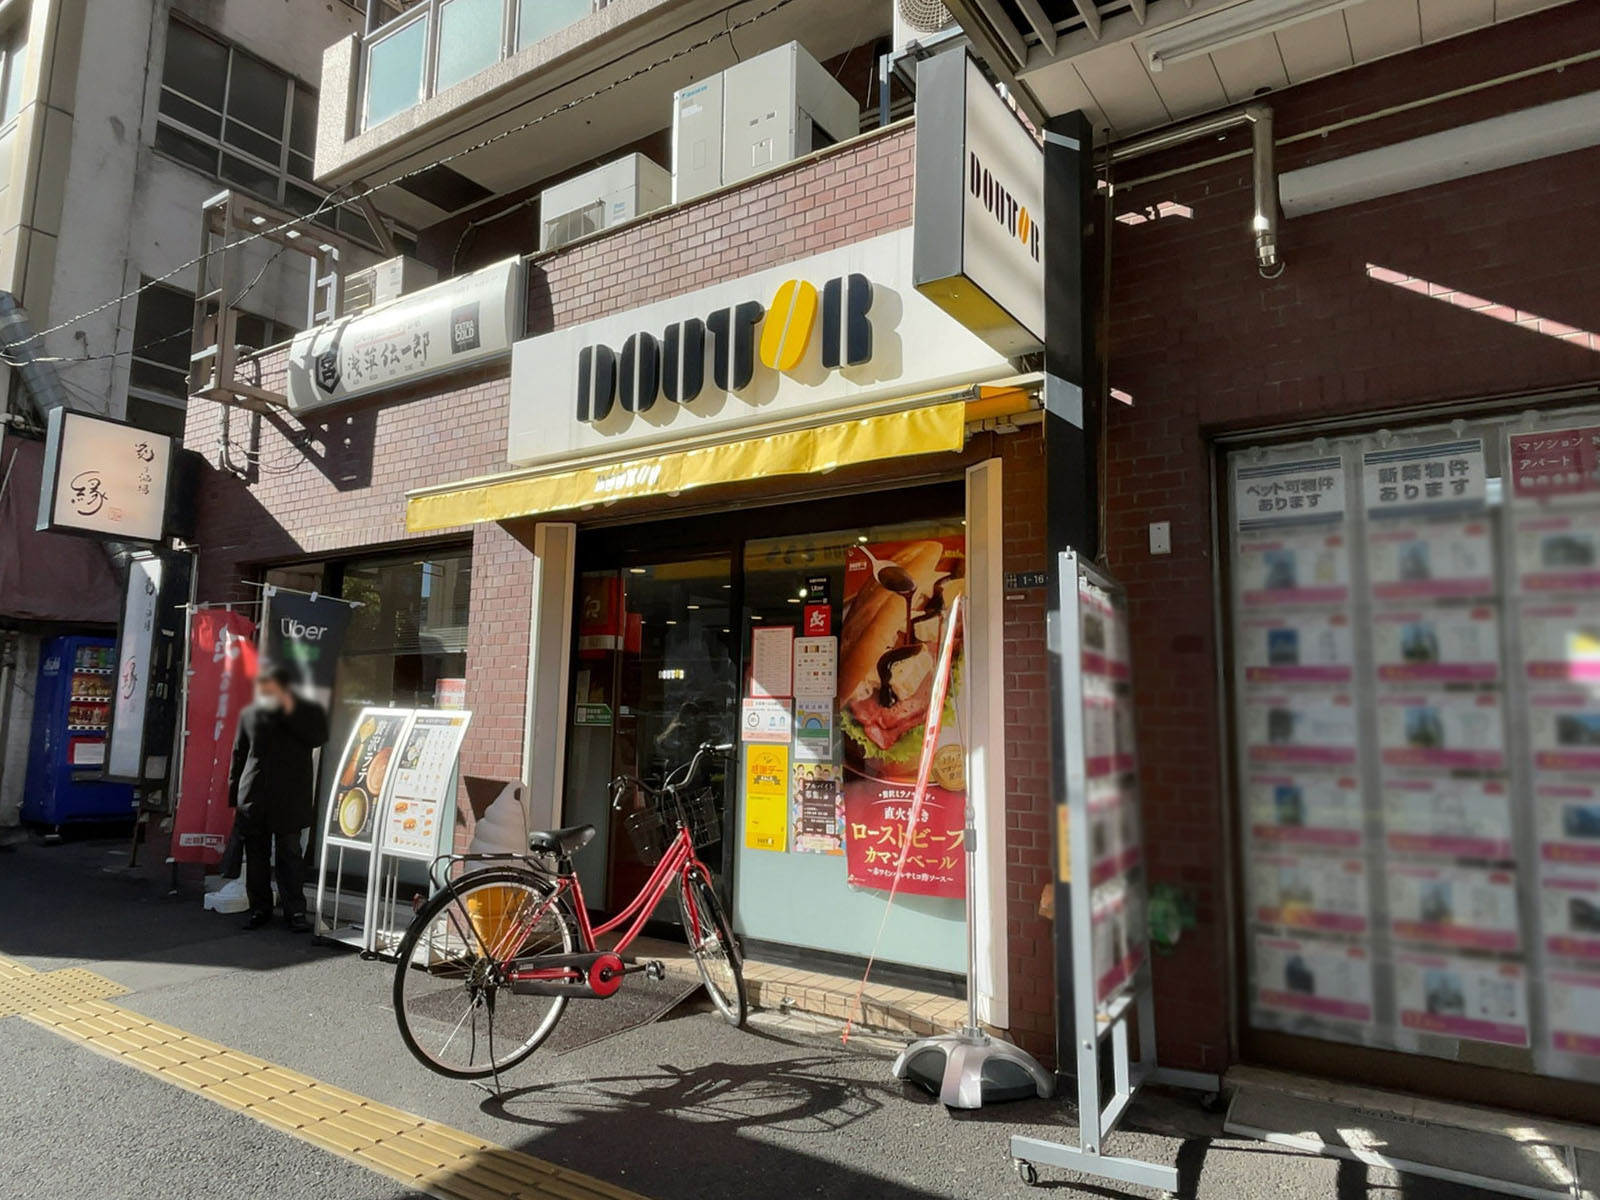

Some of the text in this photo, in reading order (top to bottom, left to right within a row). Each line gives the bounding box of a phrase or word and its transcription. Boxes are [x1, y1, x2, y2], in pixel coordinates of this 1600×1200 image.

[970, 151, 1040, 263] DOUTOR
[576, 273, 874, 423] DOUTOR
[1518, 437, 1584, 451] マンション
[1378, 460, 1470, 485] 新築物件
[1519, 455, 1571, 470] アパート
[70, 470, 109, 516] 縁
[1246, 476, 1334, 497] ペット可物件
[1379, 479, 1469, 502] あります
[1258, 494, 1322, 512] あります
[281, 618, 328, 640] Uber
[851, 823, 965, 851] ローストビーフ
[864, 846, 958, 870] カマンベール
